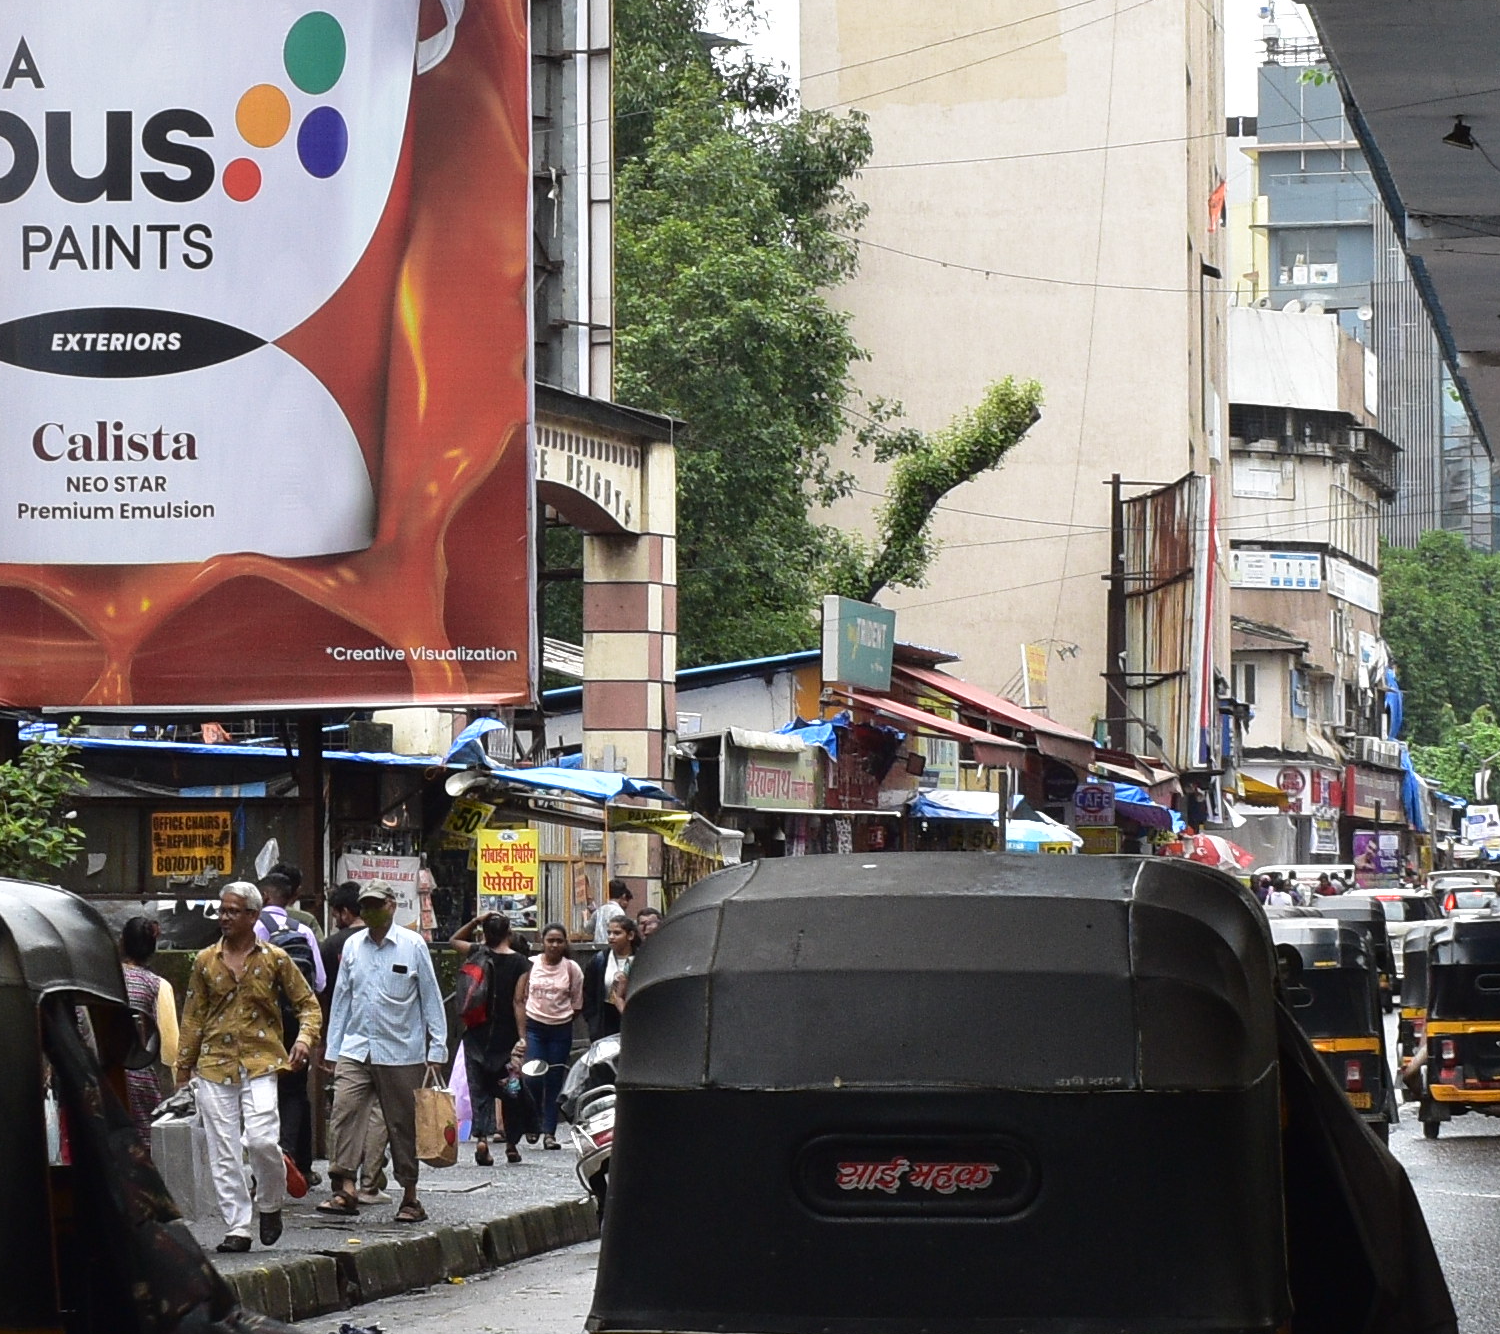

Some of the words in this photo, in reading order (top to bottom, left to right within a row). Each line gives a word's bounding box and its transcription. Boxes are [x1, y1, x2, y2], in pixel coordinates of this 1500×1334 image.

[22, 223, 214, 271] PAINTS
[51, 332, 182, 351] EXTERIORS
[32, 420, 199, 462] Calista
[66, 476, 108, 492] NEO
[113, 475, 167, 493] STAR
[17, 501, 113, 519] Premium
[119, 500, 215, 518] Emulsion
[409, 645, 518, 662] Visualization
[153, 816, 183, 831] OFFICE
[185, 815, 219, 830] CHAIRS
[166, 834, 214, 848] REPAIRING
